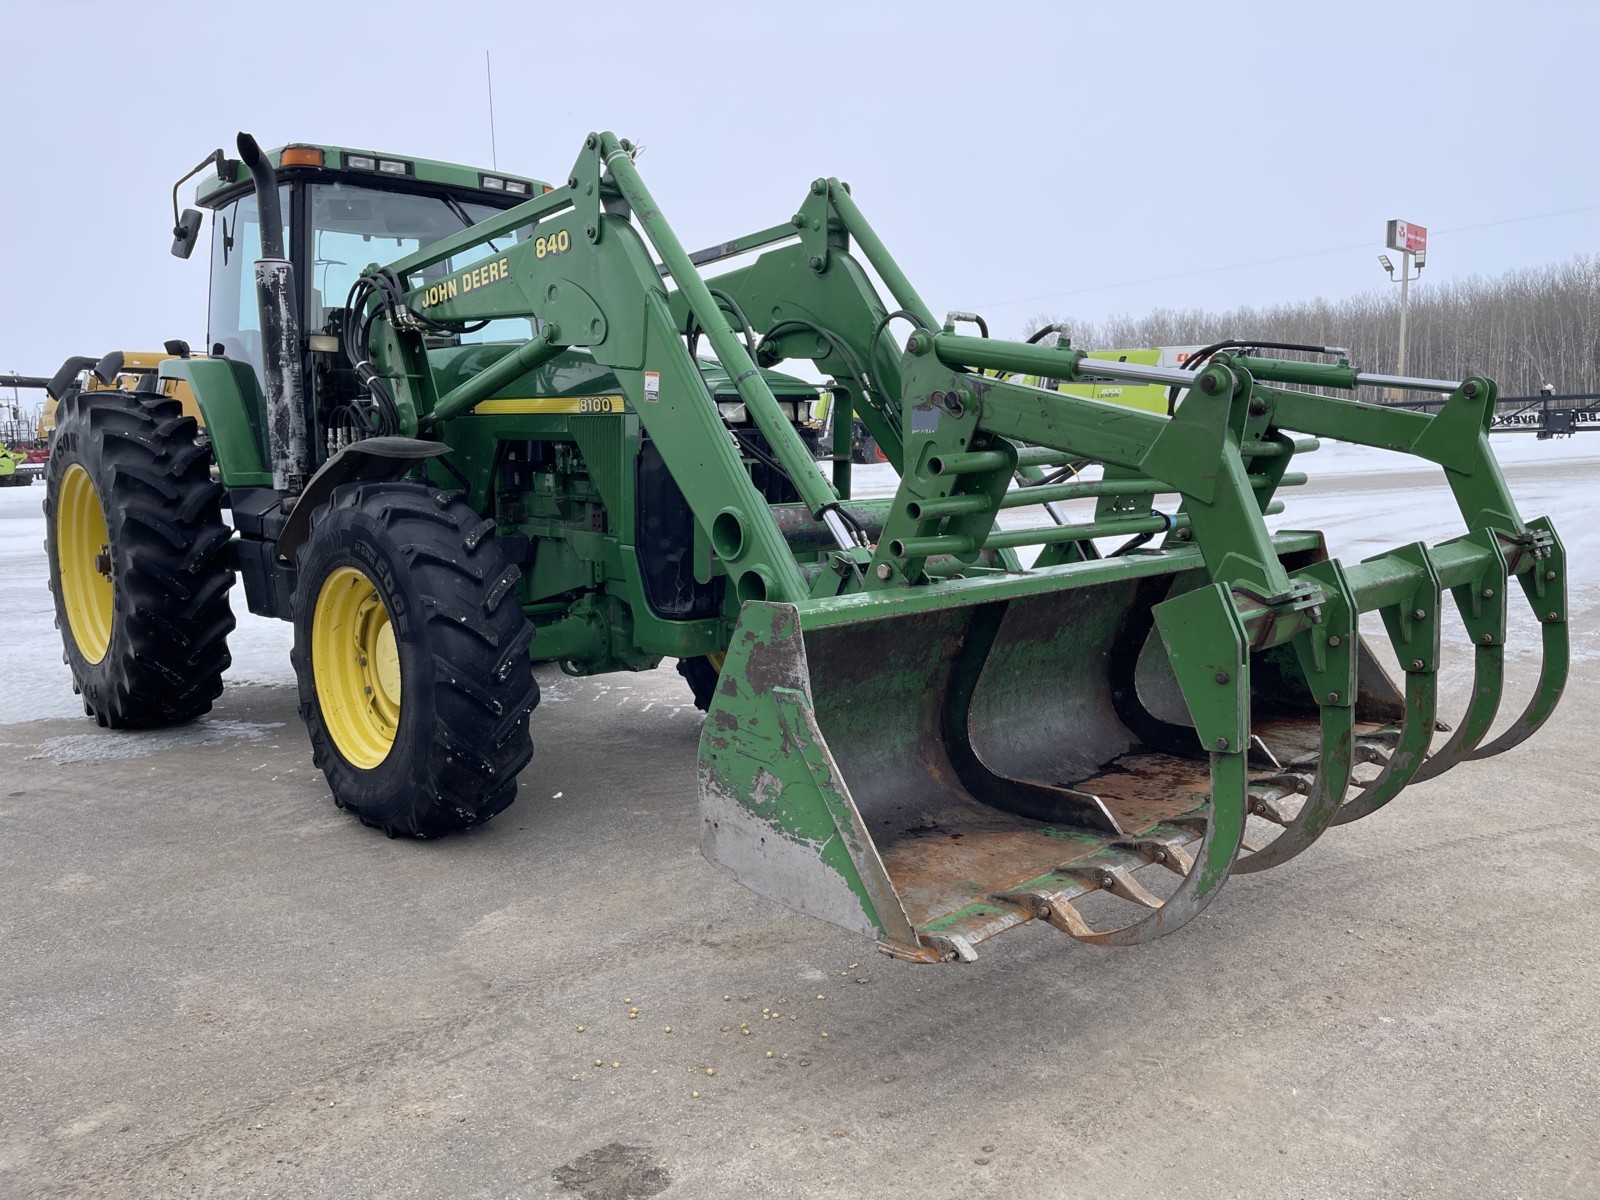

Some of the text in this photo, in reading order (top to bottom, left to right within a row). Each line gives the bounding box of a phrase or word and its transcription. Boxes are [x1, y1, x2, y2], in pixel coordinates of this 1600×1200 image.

[535, 229, 571, 259] 840
[422, 257, 509, 309] JOHN DEERE
[579, 398, 611, 413] 8100
